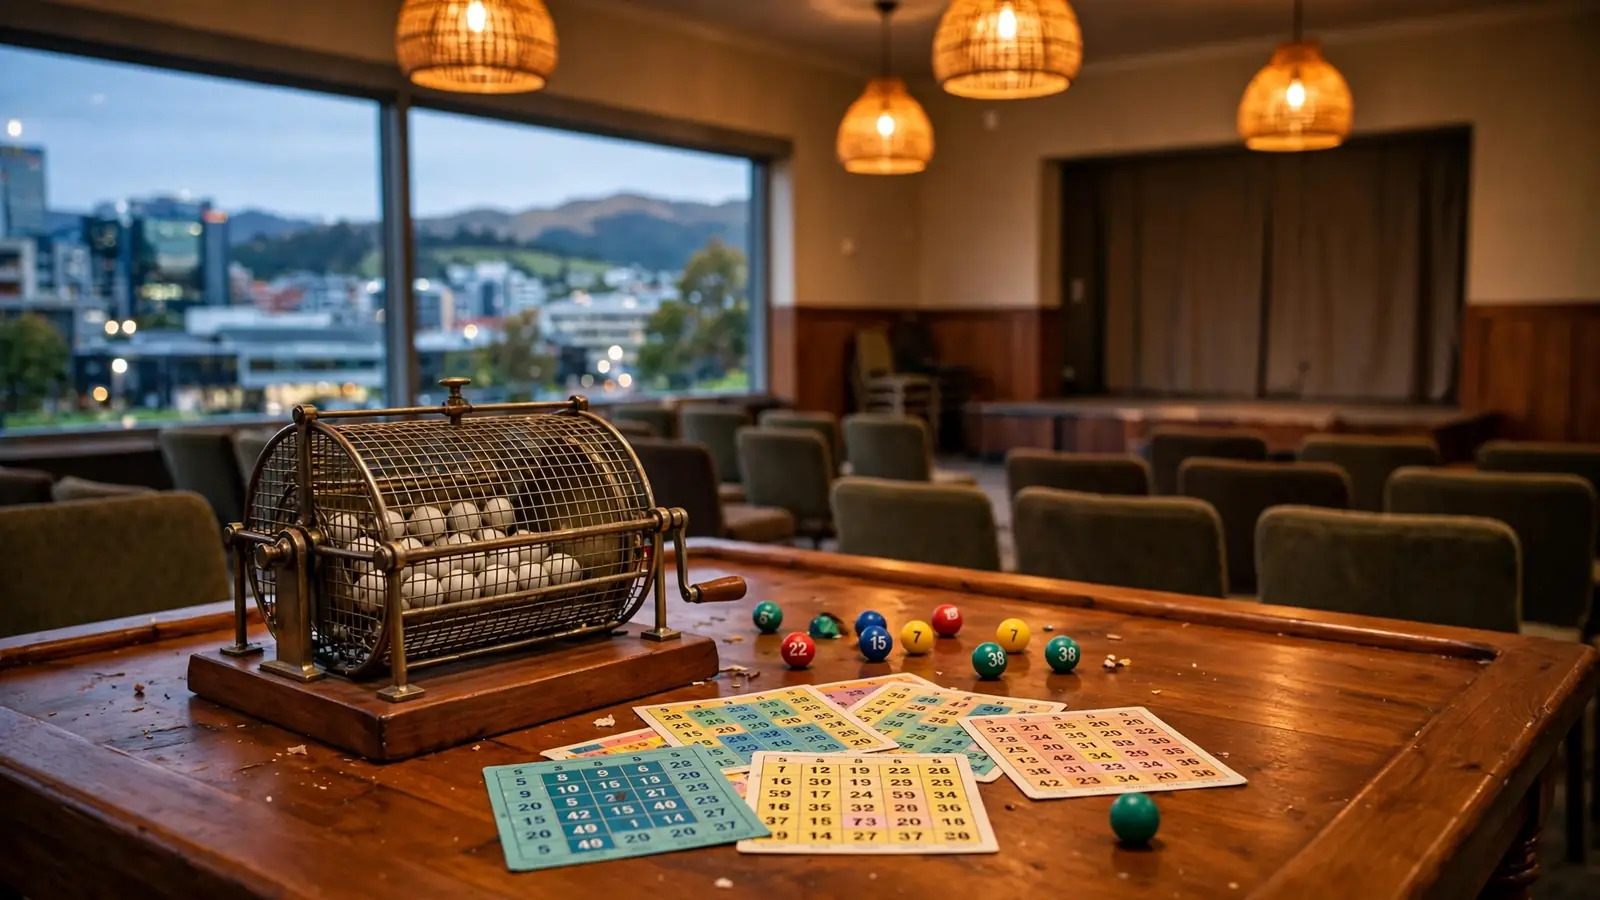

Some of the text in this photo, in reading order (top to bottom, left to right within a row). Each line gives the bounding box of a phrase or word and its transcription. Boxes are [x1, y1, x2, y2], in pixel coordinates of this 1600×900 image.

[914, 631, 921, 643] 7
[1011, 629, 1018, 642] 7
[789, 642, 808, 657] 22
[871, 636, 887, 650] 15
[987, 652, 1005, 667] 38
[1059, 647, 1076, 662] 38
[1054, 754, 1076, 762] 42
[1089, 752, 1113, 760] 34
[928, 767, 951, 775] 28
[1027, 768, 1051, 776] 38
[1064, 765, 1087, 773] 31
[1102, 763, 1126, 771] 23
[516, 778, 527, 786] 5
[557, 785, 580, 794] 10
[678, 771, 701, 780] 20
[1040, 780, 1064, 788] 42
[1076, 776, 1101, 785] 23
[1115, 774, 1140, 783] 34
[519, 802, 542, 812] 20
[605, 792, 626, 803] 2
[646, 788, 666, 798] 27
[686, 783, 709, 792] 23
[769, 790, 792, 798] 59
[811, 791, 831, 799] 17
[850, 791, 873, 799] 24
[893, 791, 916, 799] 59
[523, 816, 546, 826] 15
[568, 810, 591, 820] 42
[612, 806, 635, 815] 15
[695, 795, 719, 805] 23
[809, 804, 832, 812] 35
[851, 804, 874, 812] 32
[937, 804, 961, 812] 36
[527, 830, 552, 840] 20
[663, 813, 685, 824] 14
[704, 808, 725, 818] 27
[714, 821, 736, 831] 37
[766, 817, 789, 825] 37
[853, 818, 877, 826] 73
[897, 818, 921, 827] 20
[810, 832, 832, 840] 14
[854, 832, 878, 840] 27
